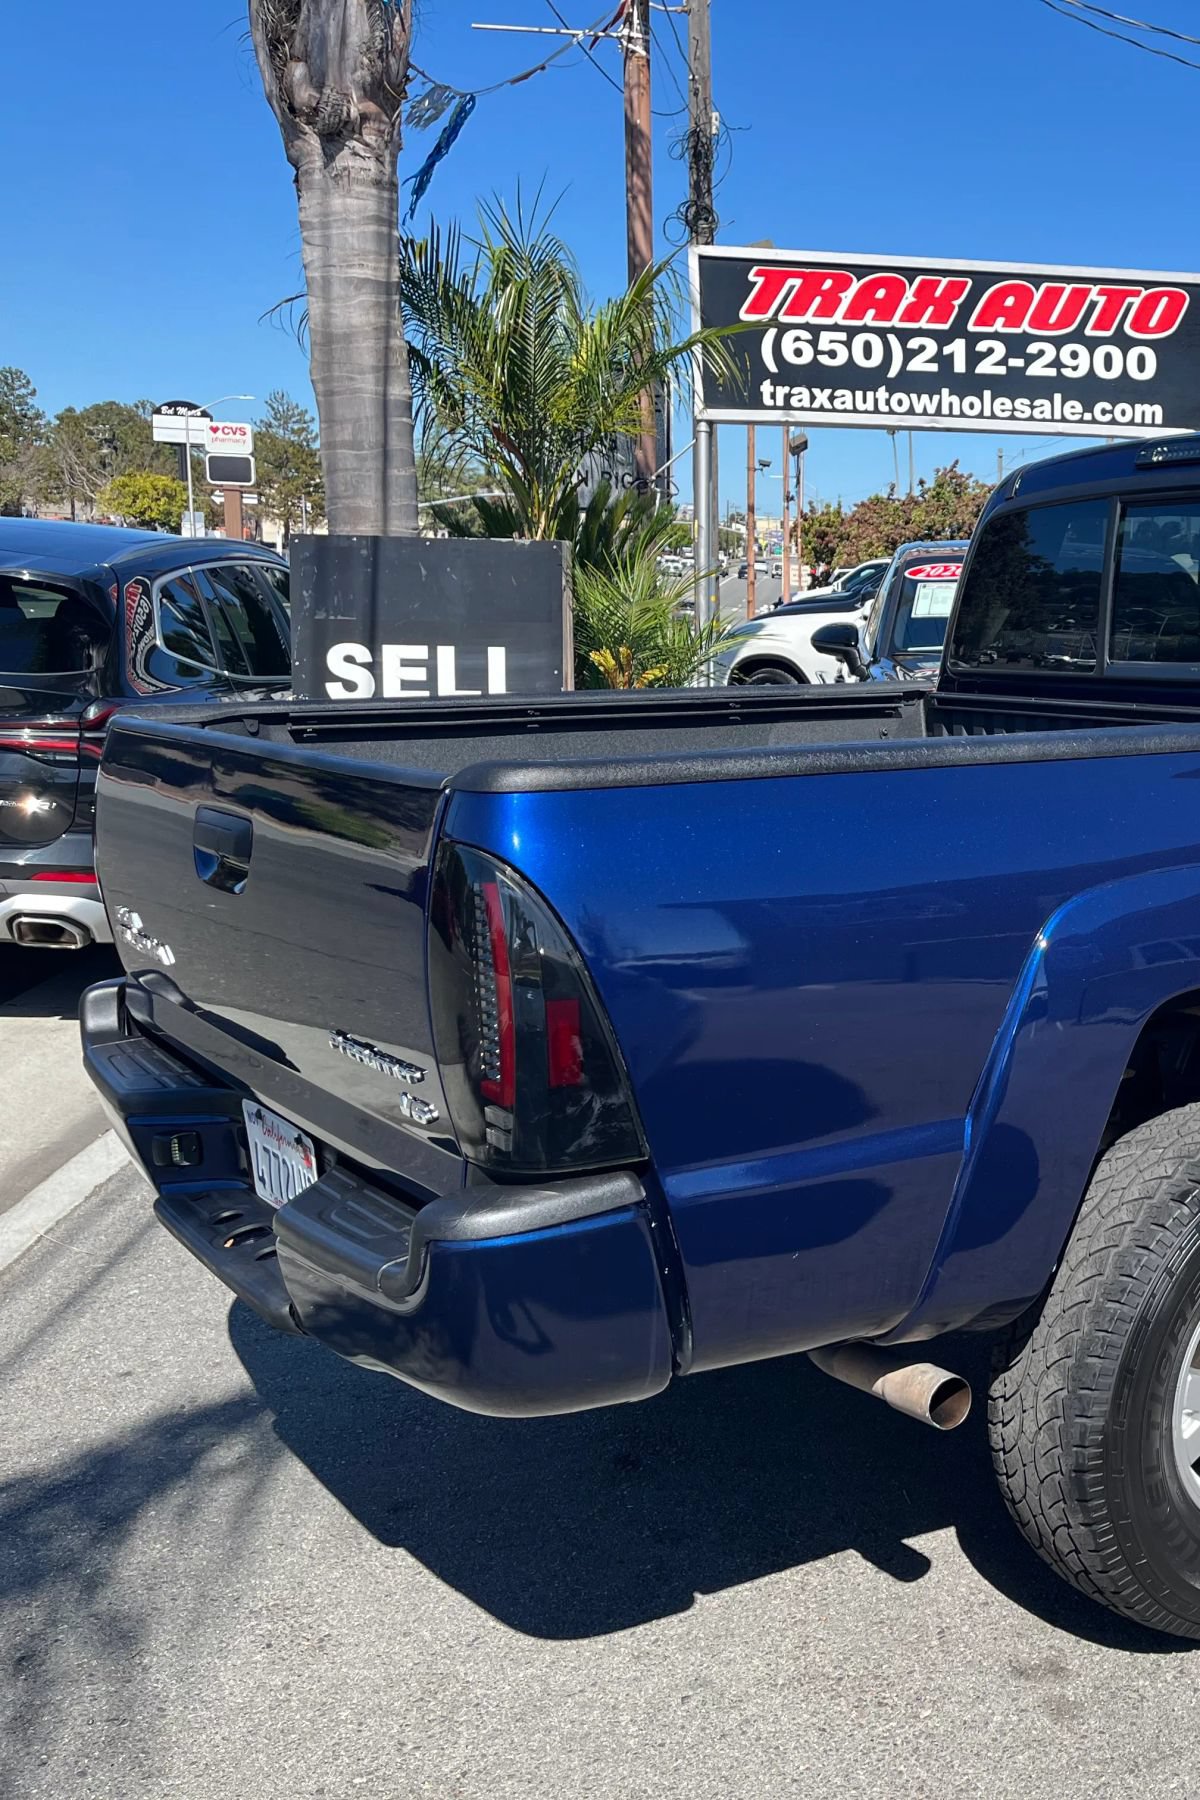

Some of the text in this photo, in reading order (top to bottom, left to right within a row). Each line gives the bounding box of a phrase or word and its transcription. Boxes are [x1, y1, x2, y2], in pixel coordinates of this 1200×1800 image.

[739, 266, 1190, 339] TRAX AUTO
[761, 328, 1157, 380] (650)212-2900
[760, 379, 1163, 424] traxautowholesale.com
[221, 426, 247, 436] CVS
[399, 1091, 440, 1125] V6
